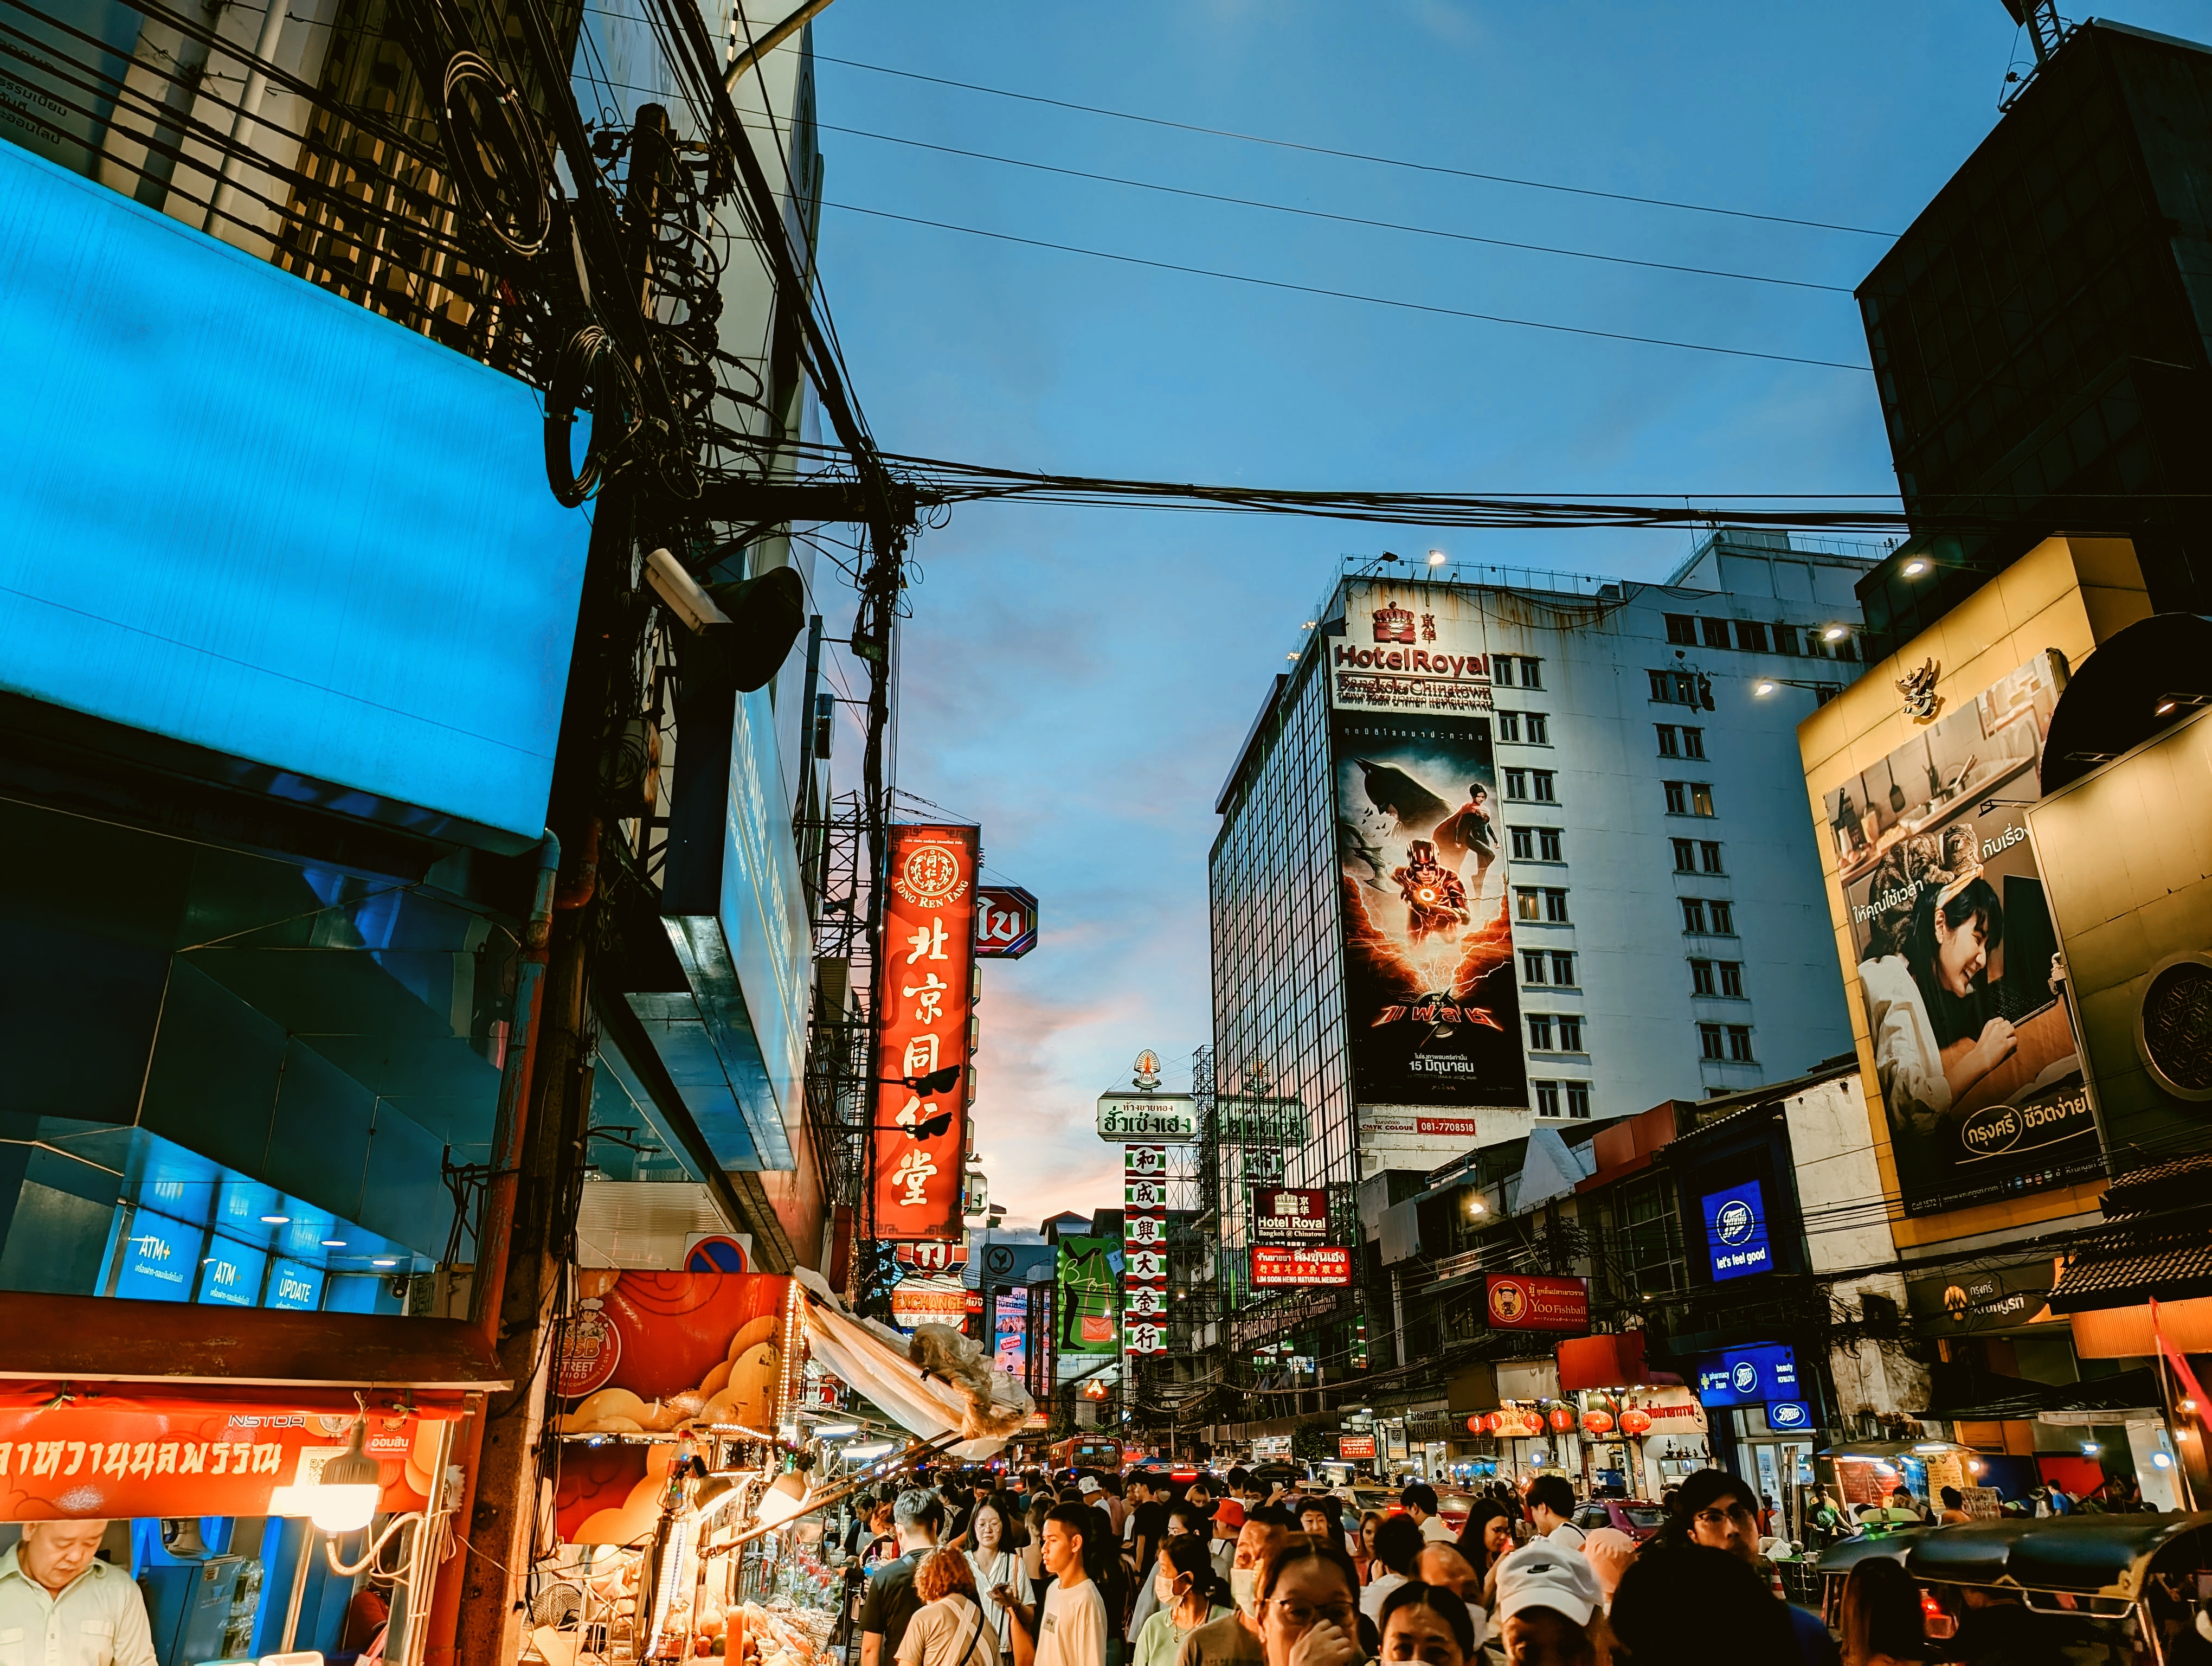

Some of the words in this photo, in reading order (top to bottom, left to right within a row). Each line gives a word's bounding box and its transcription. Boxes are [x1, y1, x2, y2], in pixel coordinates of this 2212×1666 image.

[1336, 644, 1410, 672] Hotel
[1412, 650, 1490, 678] Royal
[924, 855, 937, 892] 同仁堂
[1852, 880, 1924, 924] ให้คุณใช้เวลา
[892, 917, 949, 1206] 北京同仁堂
[1409, 1061, 1422, 1071] 15
[1425, 1059, 1474, 1075] มิถุนายน
[1122, 1101, 1174, 1112] ห้างขายทอง
[1104, 1106, 1192, 1133] ฮั่วเซ่งเฮง
[1421, 1122, 1474, 1132] 081-7708518
[1967, 1112, 2016, 1146] กรุงศรี
[1258, 1216, 1289, 1228] Hotel
[1292, 1216, 1326, 1229] Royal
[1258, 1229, 1285, 1238] Bangkok
[1716, 1256, 1731, 1270] let's
[1732, 1252, 1746, 1266] feel
[1746, 1247, 1766, 1265] good
[279, 1278, 312, 1303] UPDATE
[893, 1295, 965, 1311] EXCHANGE
[1554, 1304, 1586, 1315] Fishball
[1737, 1368, 1753, 1387] Boots
[1776, 1363, 1793, 1373] beauty
[228, 1414, 306, 1428] NSTDA
[1778, 1407, 1800, 1421] Boots
[371, 1436, 409, 1447] ออมสิน
